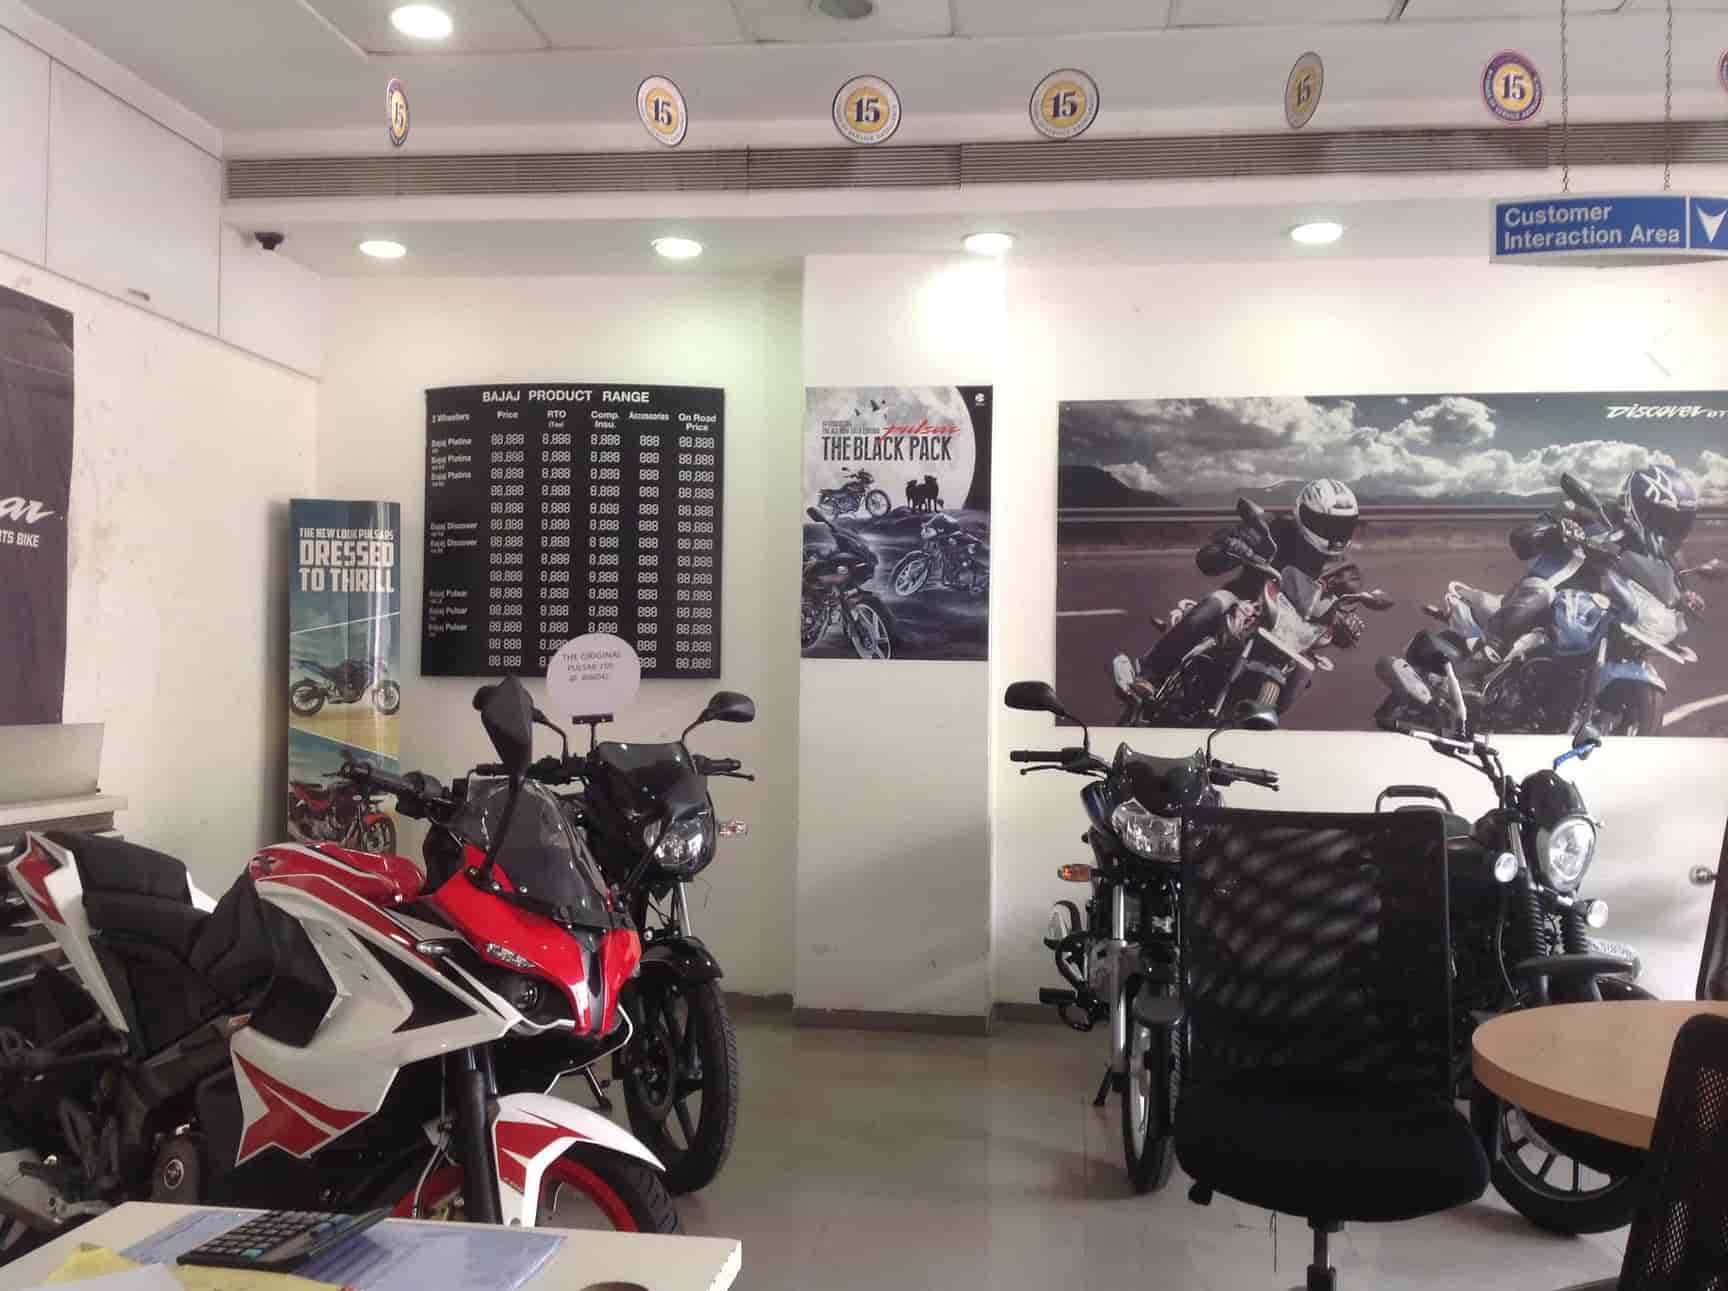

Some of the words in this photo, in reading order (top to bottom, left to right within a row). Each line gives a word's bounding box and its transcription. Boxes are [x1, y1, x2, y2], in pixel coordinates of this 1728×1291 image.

[1502, 73, 1526, 99] 15
[856, 97, 880, 122] 15
[1053, 91, 1077, 117] 15
[653, 98, 672, 125] 15
[1504, 206, 1613, 227] Customer
[1504, 227, 1622, 250] Interaction
[1630, 224, 1680, 243] Area
[482, 390, 520, 402] BAJAJ
[528, 390, 592, 401] PRODUCT
[602, 391, 650, 403] RANGE
[497, 411, 518, 419] Price
[547, 410, 567, 418] RTO
[591, 411, 619, 420] Comp.
[678, 413, 691, 421] On
[693, 414, 716, 423] Road
[595, 420, 616, 428] Insu.
[686, 423, 708, 431] Price
[448, 438, 472, 446] Platina
[640, 435, 660, 447] 888
[821, 436, 851, 461] THE
[853, 436, 904, 461] BLACK
[910, 435, 952, 461] PACK
[640, 452, 659, 463] 888
[640, 469, 659, 480] 888
[639, 486, 659, 497] 888
[639, 504, 659, 515] 888
[639, 520, 658, 531] 888
[299, 528, 314, 537] THE
[16, 532, 40, 548] BIKE
[638, 537, 658, 548] 888
[299, 540, 394, 566] DRESSED
[638, 555, 658, 566] 888
[299, 567, 325, 592] TO
[330, 567, 394, 592] THRILL
[638, 572, 658, 583] 888
[446, 589, 468, 598] Pulsar
[638, 589, 657, 600] 888
[446, 607, 467, 615] Pulsar
[638, 606, 657, 617] 888
[445, 623, 467, 632] Pulsar
[637, 623, 657, 634] 888
[638, 640, 656, 652] 888
